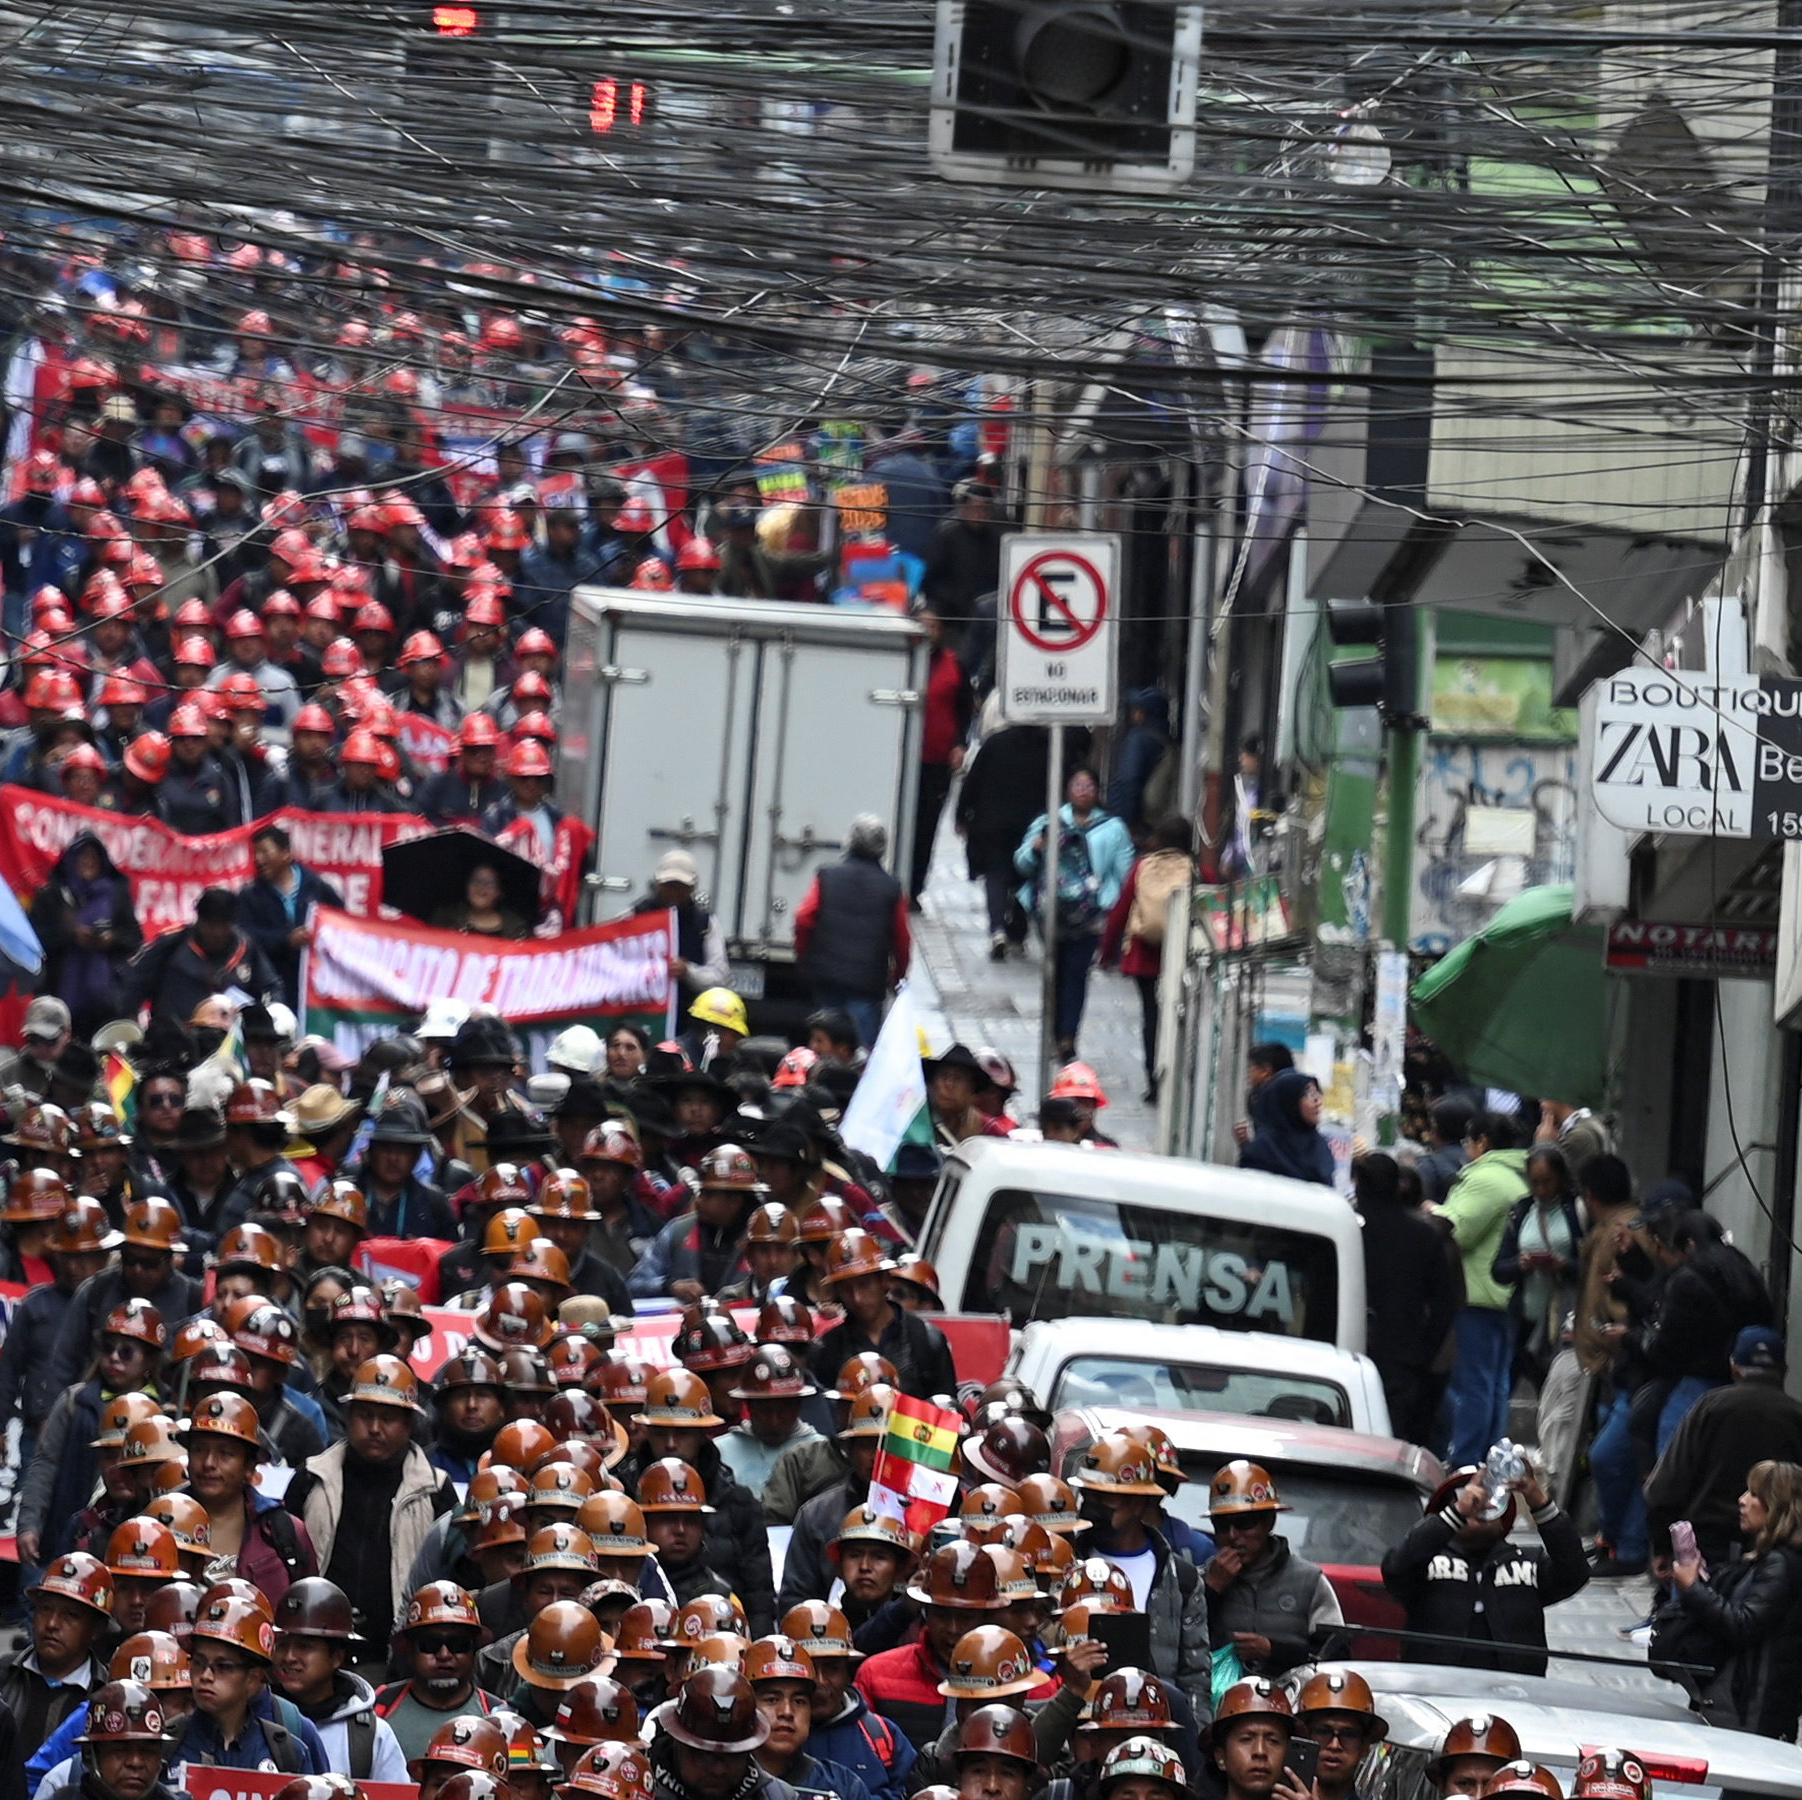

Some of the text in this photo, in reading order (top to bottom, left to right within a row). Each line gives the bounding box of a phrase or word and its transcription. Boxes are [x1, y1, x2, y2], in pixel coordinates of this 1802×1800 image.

[1047, 661, 1065, 677] NO
[1594, 720, 1749, 793] ZARA
[1647, 803, 1744, 832] LOCAL
[1012, 1222, 1295, 1323] PRENSA
